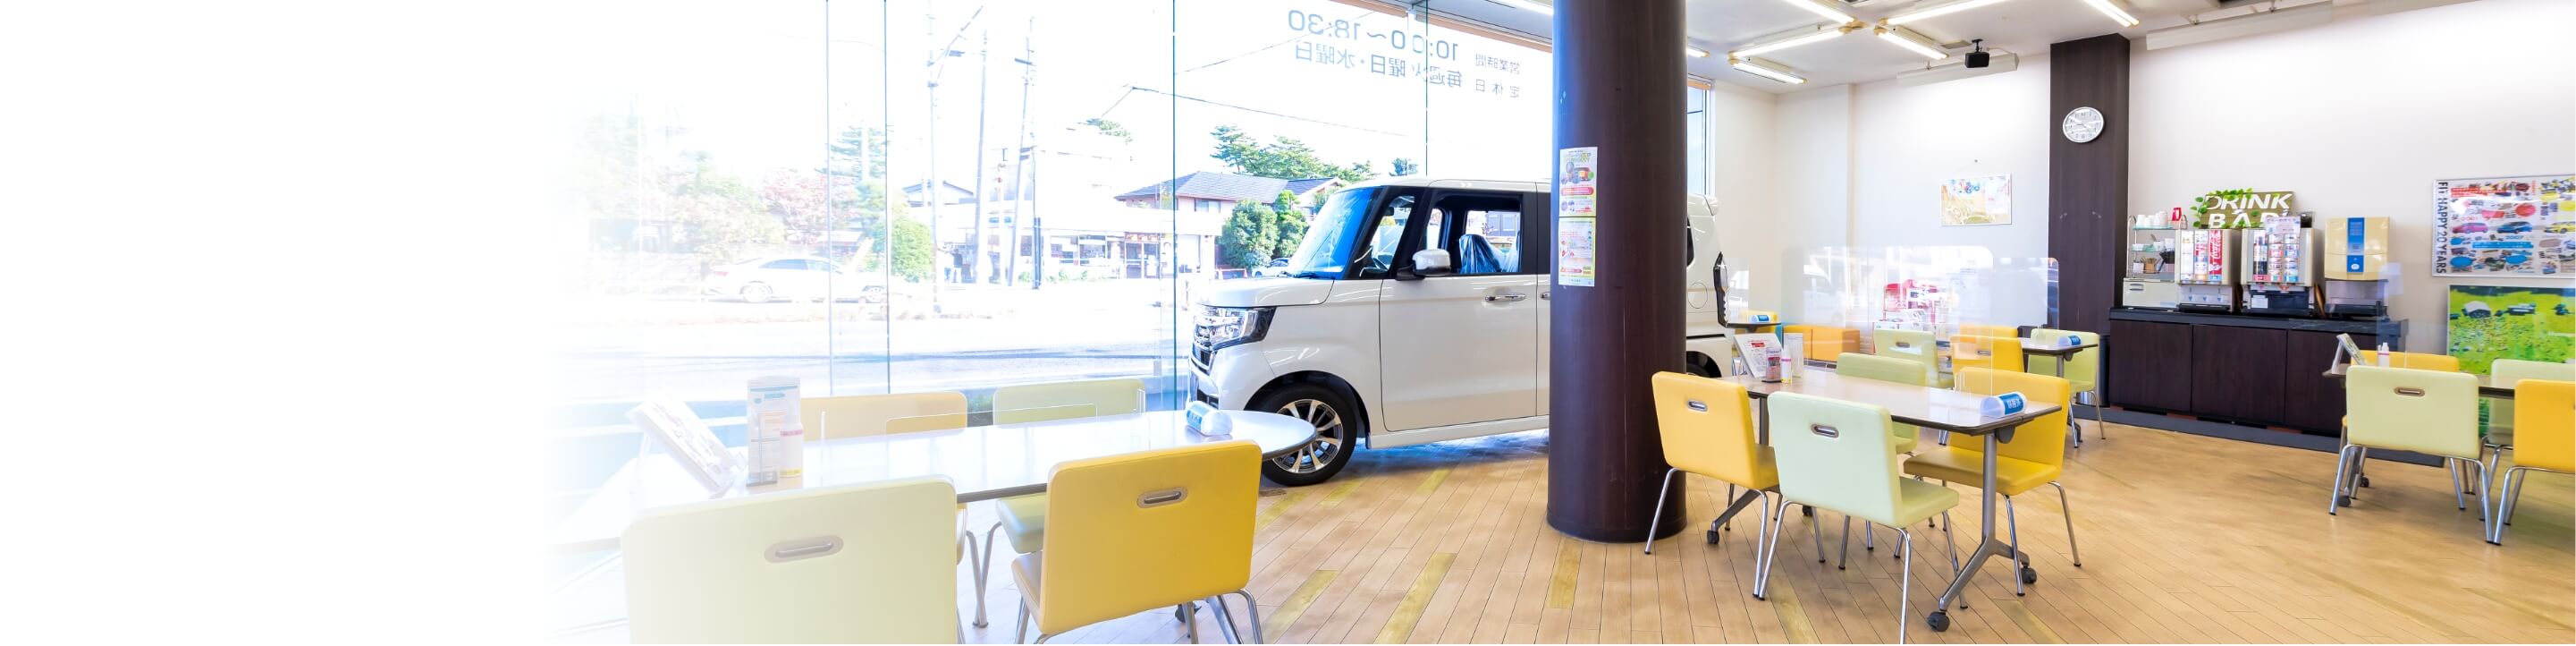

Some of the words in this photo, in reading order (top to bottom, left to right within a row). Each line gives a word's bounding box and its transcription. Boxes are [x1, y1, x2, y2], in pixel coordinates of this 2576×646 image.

[2205, 193, 2293, 210] DRINK
[2437, 198, 2448, 229] HAPPY
[2437, 231, 2447, 243] 20
[2436, 244, 2447, 274] YEARS
